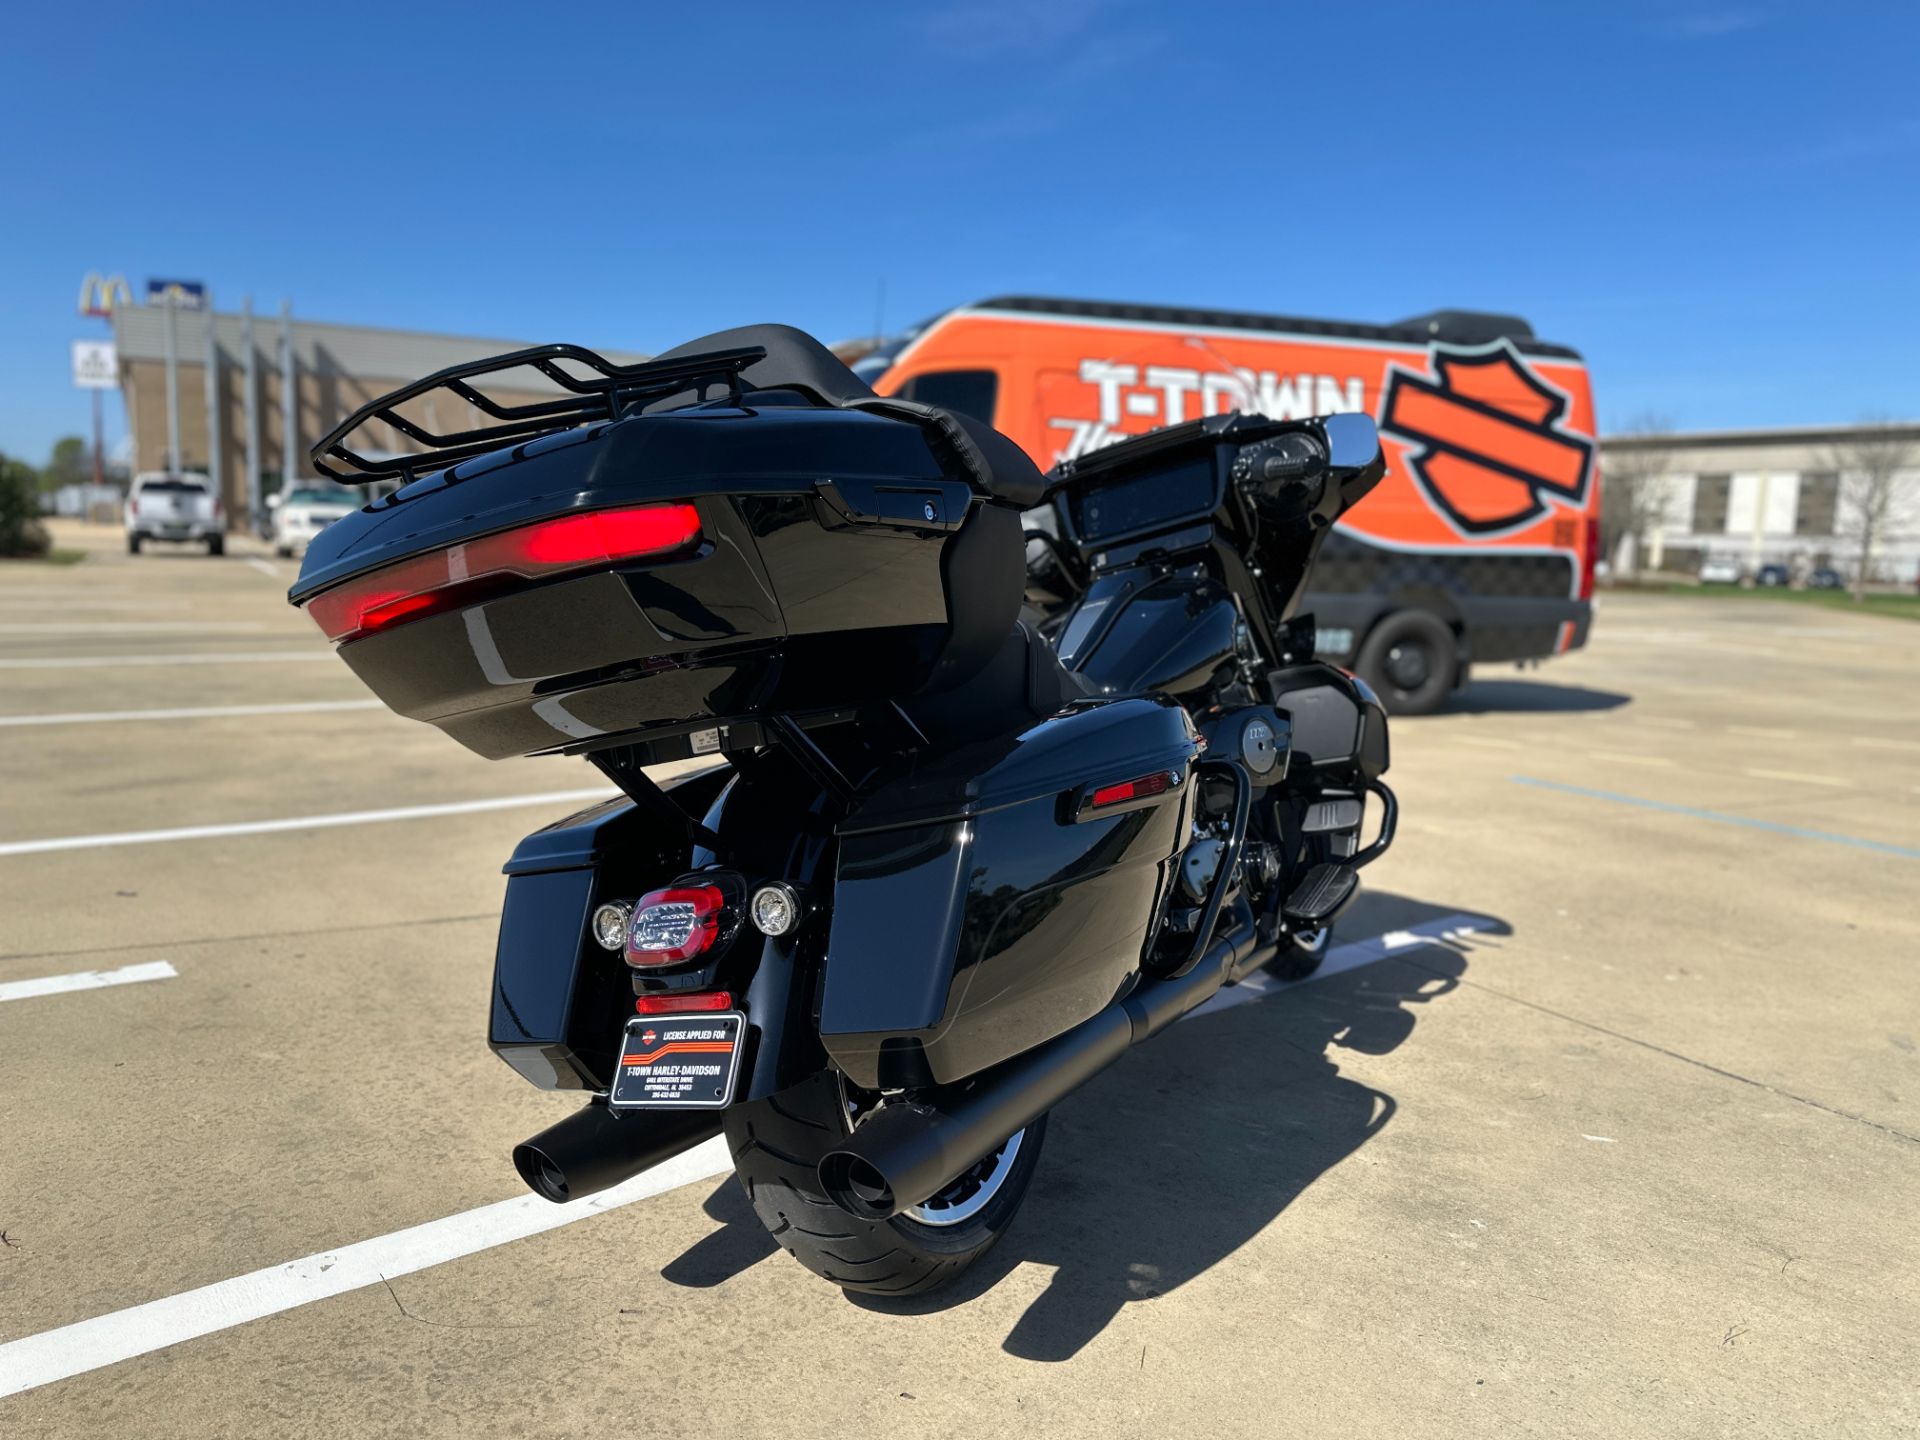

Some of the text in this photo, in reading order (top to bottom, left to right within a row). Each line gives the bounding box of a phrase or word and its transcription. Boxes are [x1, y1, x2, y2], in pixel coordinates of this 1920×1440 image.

[1079, 359, 1364, 430] T-TOWN
[663, 1031, 686, 1040] LICENSE
[686, 1030, 712, 1040] APPLIED
[712, 1030, 726, 1039] FOR
[627, 1065, 720, 1076] T-TOWN HARLEY-DAVIDSON
